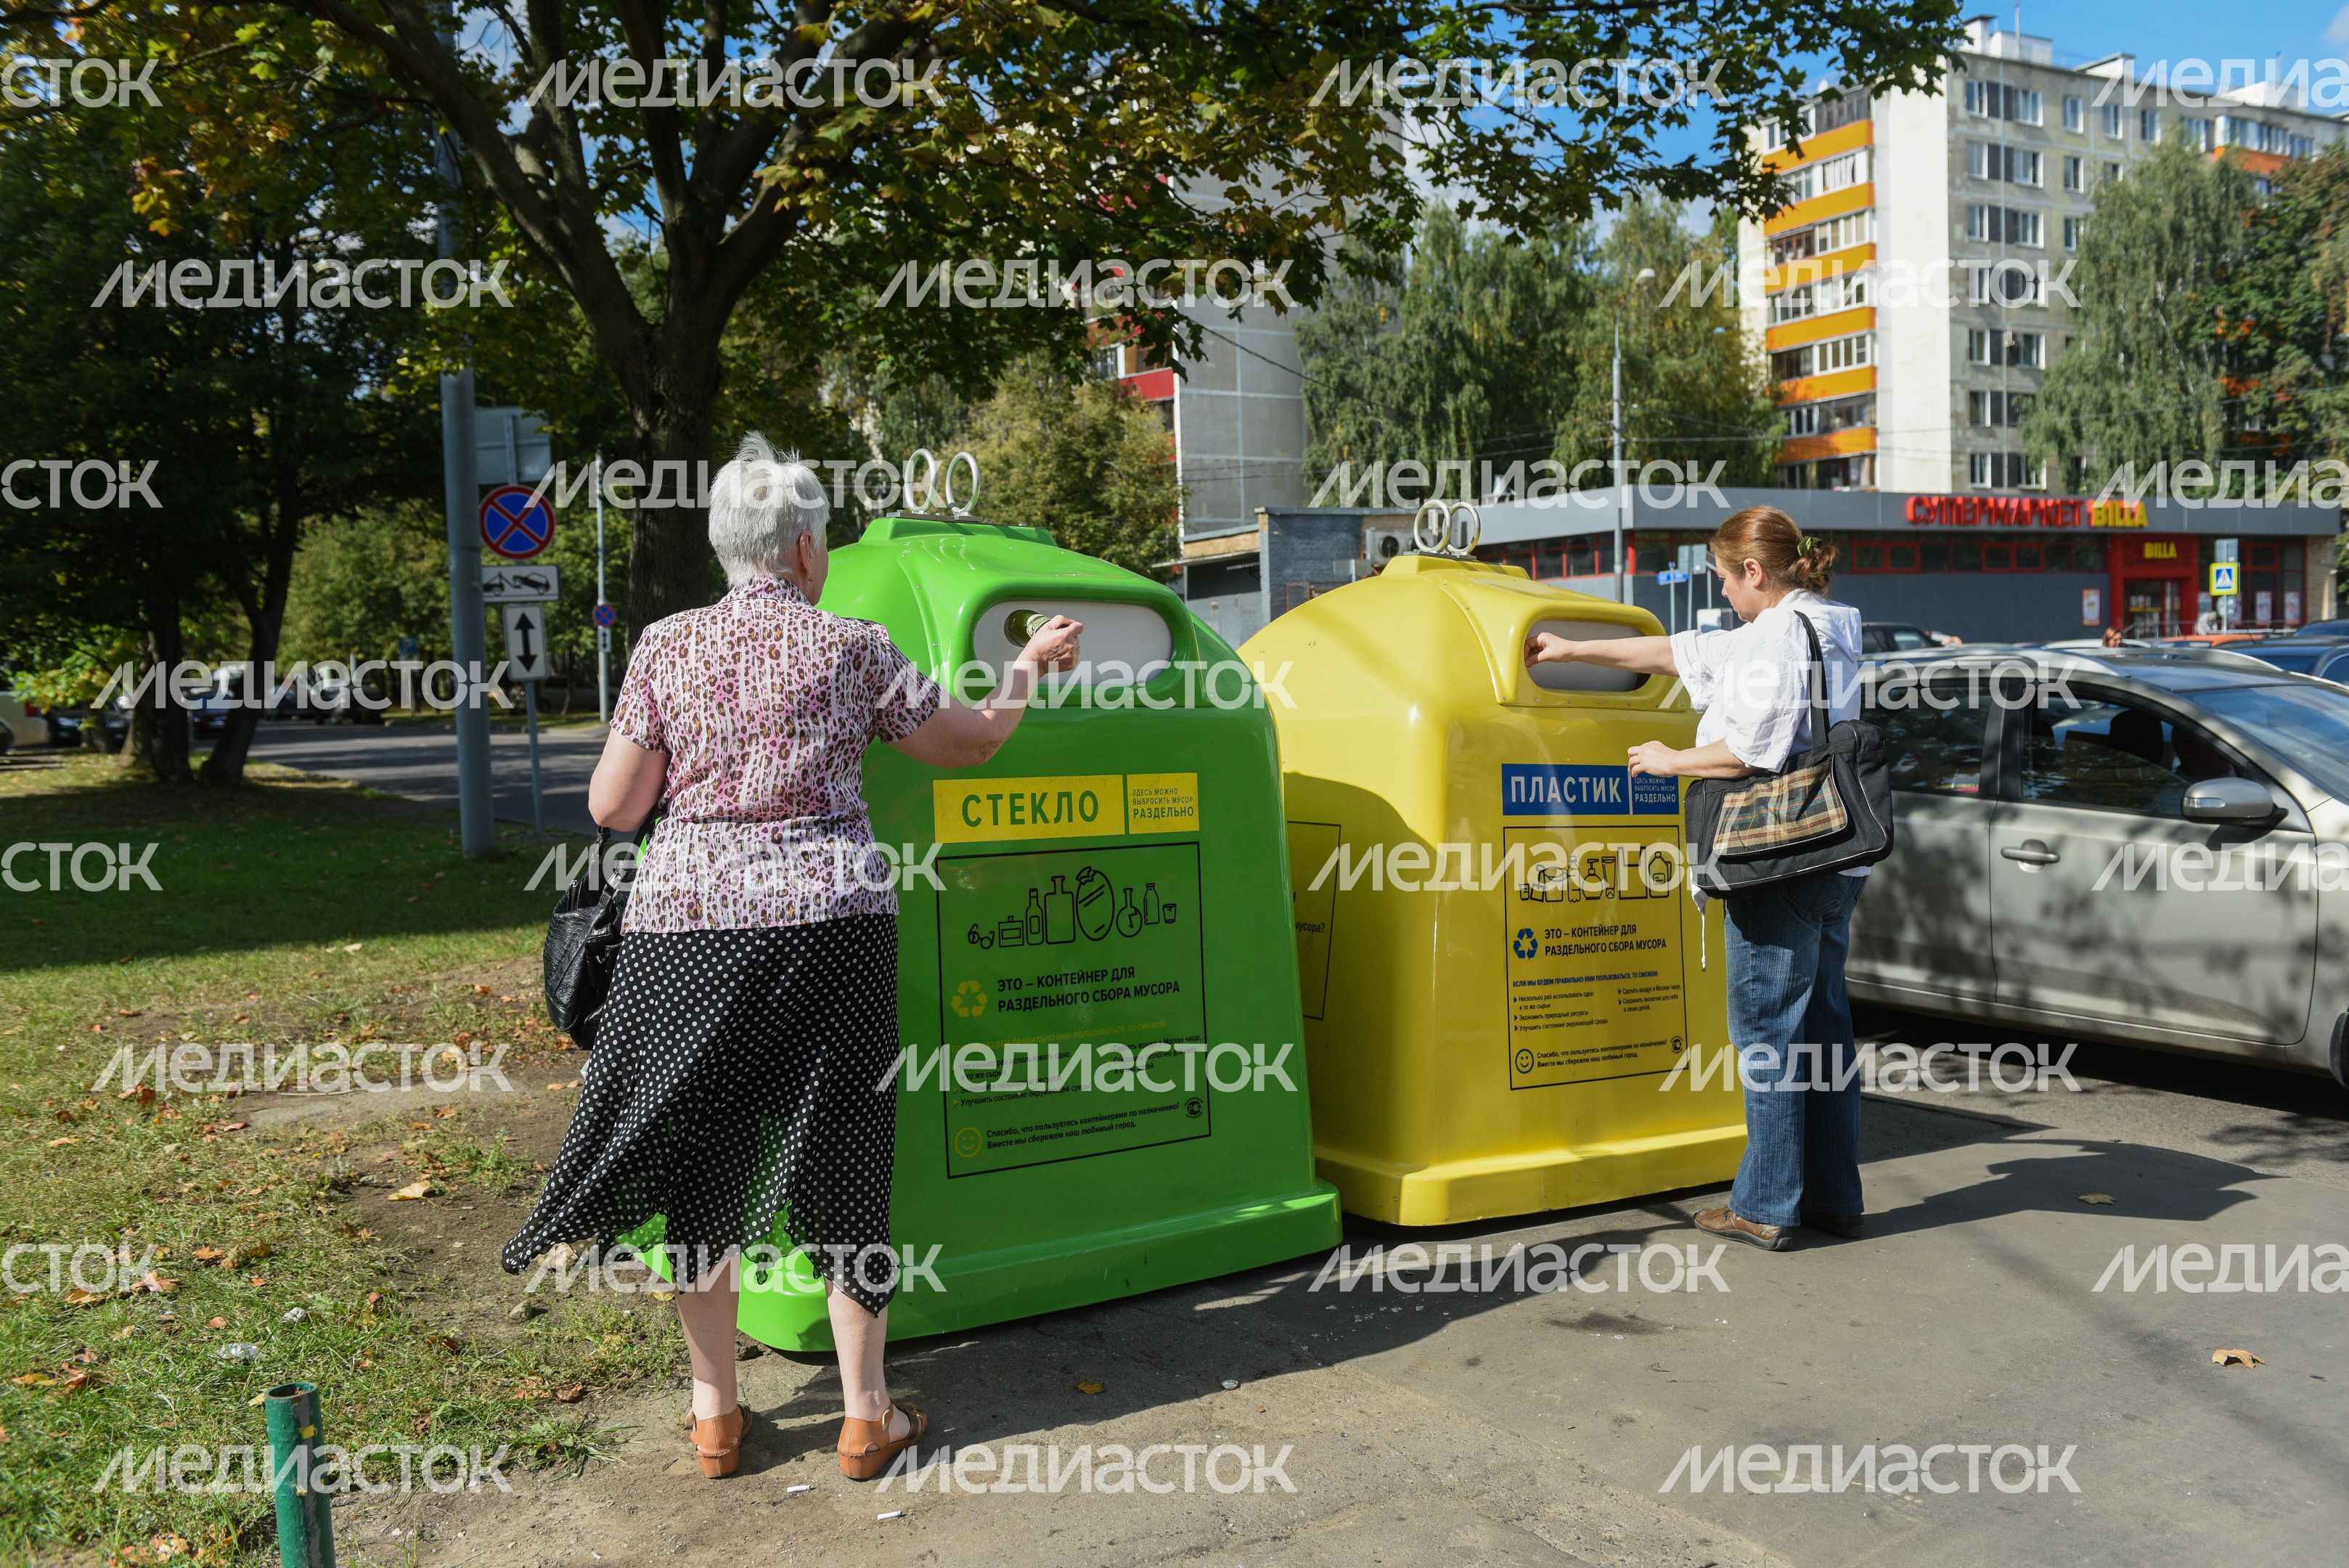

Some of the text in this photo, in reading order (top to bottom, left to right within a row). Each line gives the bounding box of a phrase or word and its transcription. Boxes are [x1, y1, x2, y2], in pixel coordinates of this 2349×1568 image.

[1905, 496, 2149, 528] СУПЕРМАРКЕТ BILLA
[2144, 542, 2177, 559] BILLA
[1132, 788, 1153, 797] ЗДЕСЬ
[1511, 776, 1622, 803] ПЛАСТИК
[1635, 793, 1676, 804] РАЗДЕЛЬНО
[962, 790, 1098, 827] СТЕКЛО
[1133, 805, 1194, 820] РАЗДЕЛЬНО
[1544, 928, 1561, 939] ЭТО
[1572, 923, 1618, 937] КОНТЕЙНЕР
[1620, 924, 1636, 936] ДЛЯ
[1545, 938, 1666, 957] РАЗДЕЛЬНОГО СБОРА МУСОРА
[997, 977, 1022, 992] ЭТО
[1037, 967, 1108, 988] КОНТЕЙНЕР
[1111, 965, 1135, 981] ДЛЯ
[1596, 973, 1631, 981] ПОЛЬЗОВАТЬСЯ,
[998, 980, 1180, 1014] РАЗДЕЛЬНОГО СБОРА МУСОРА
[1545, 1011, 1569, 1020] природные
[1565, 1018, 1593, 1028] окружающей
[1163, 1036, 1184, 1045] Москве
[1537, 1050, 1559, 1059] Спасибо,
[1570, 1047, 1599, 1056] пользуетесь
[1601, 1043, 1632, 1053] контейнерами
[1640, 1039, 1667, 1048] назначению!
[997, 1059, 1008, 1068] раз
[1010, 1053, 1053, 1066] использовать
[1055, 1051, 1069, 1060] одно
[1565, 1056, 1589, 1066] сбережем
[1601, 1053, 1623, 1061] любимый
[960, 1082, 1090, 1108] Улучшить состояние окружающей среды
[986, 1126, 1019, 1139] Спасибо,
[1034, 1119, 1078, 1132] пользуетесь
[1079, 1110, 1127, 1125] контейнерами
[1138, 1102, 1179, 1115] назначению!
[987, 1138, 1013, 1148] Вместе
[1028, 1130, 1063, 1144] сбережем
[1065, 1128, 1079, 1137] наш
[1082, 1123, 1113, 1135] любимый
[1115, 1120, 1135, 1131] город.
